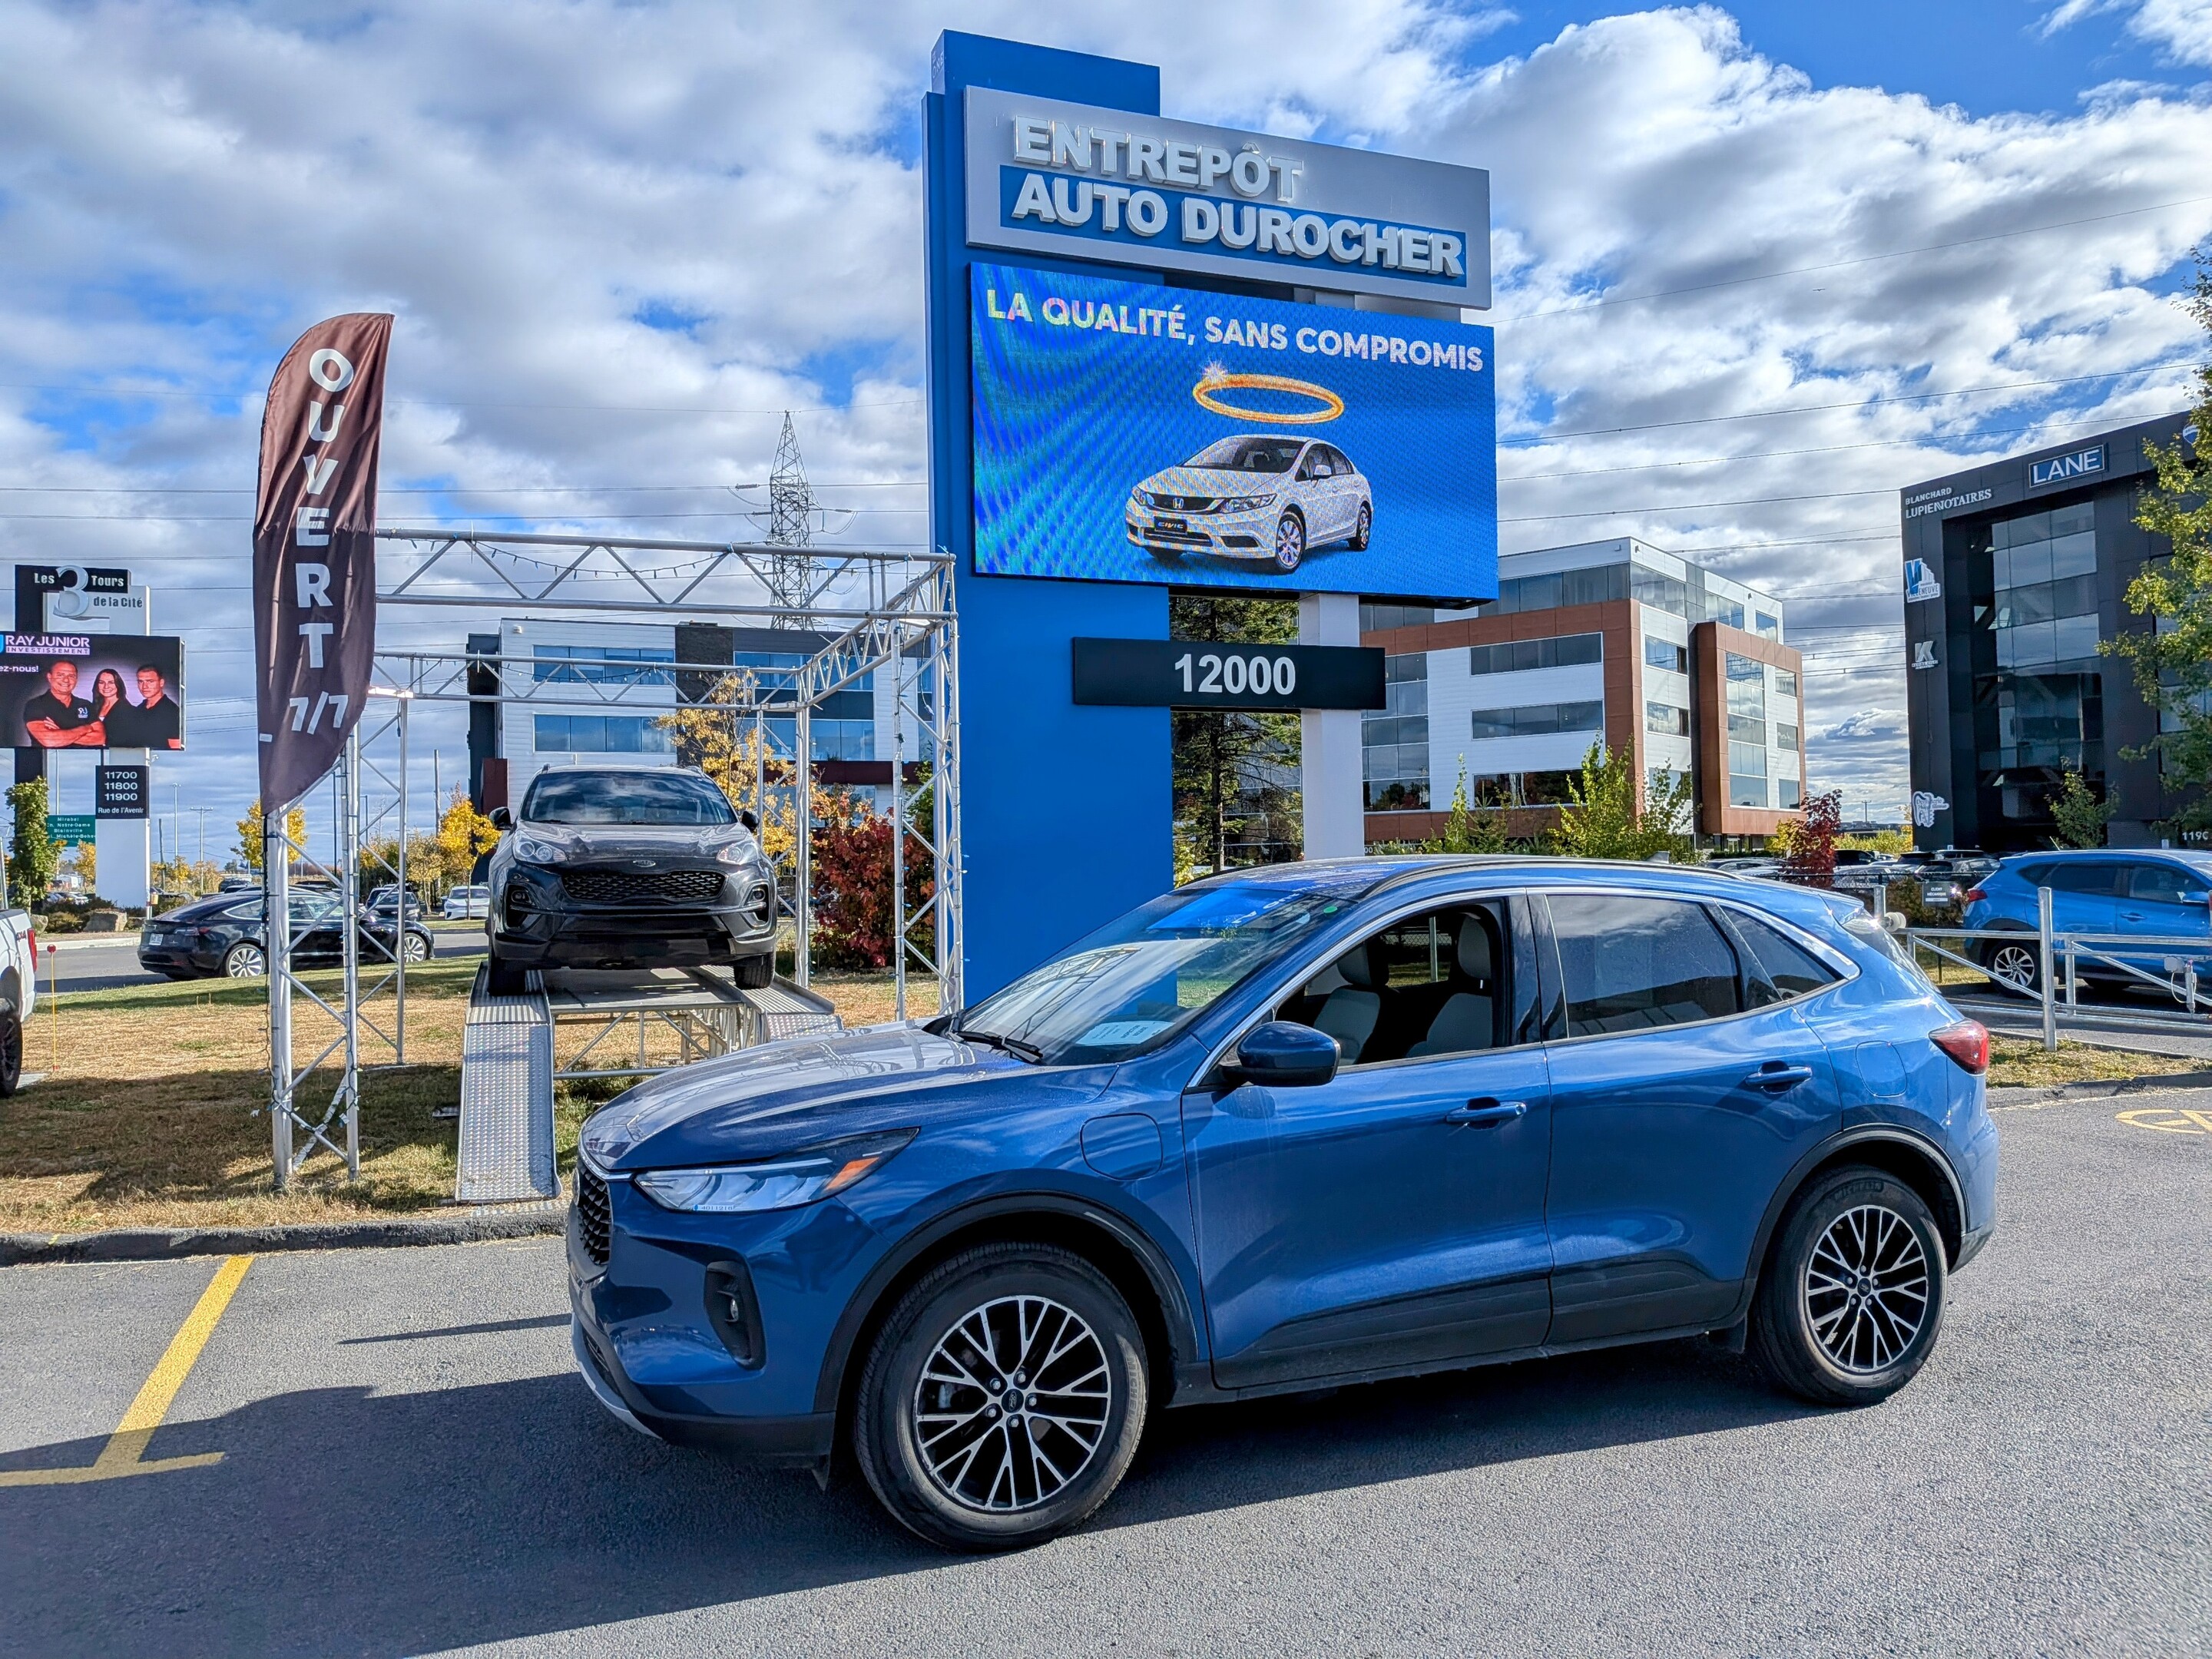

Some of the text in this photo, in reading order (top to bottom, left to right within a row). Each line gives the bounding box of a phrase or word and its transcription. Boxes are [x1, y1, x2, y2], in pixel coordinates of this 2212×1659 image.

[1013, 114, 1303, 203] ENTREPÔT
[1012, 174, 1465, 277] AUTO DUROCHER
[987, 290, 1484, 372] LA QUALITÉ, SANS COMPROMIS
[2032, 449, 2101, 485] LANE
[294, 348, 354, 669] OUVERT
[1905, 488, 1952, 505] BLANCHARD
[34, 565, 124, 618] Les 3 Tours
[93, 596, 143, 608] de la Cité
[5, 635, 90, 647] RAY JUNIOR
[1174, 654, 1296, 695] 12000
[289, 690, 349, 735] 7/7
[104, 771, 137, 780] 11700
[104, 782, 138, 790] 11800
[104, 793, 138, 801] 11900
